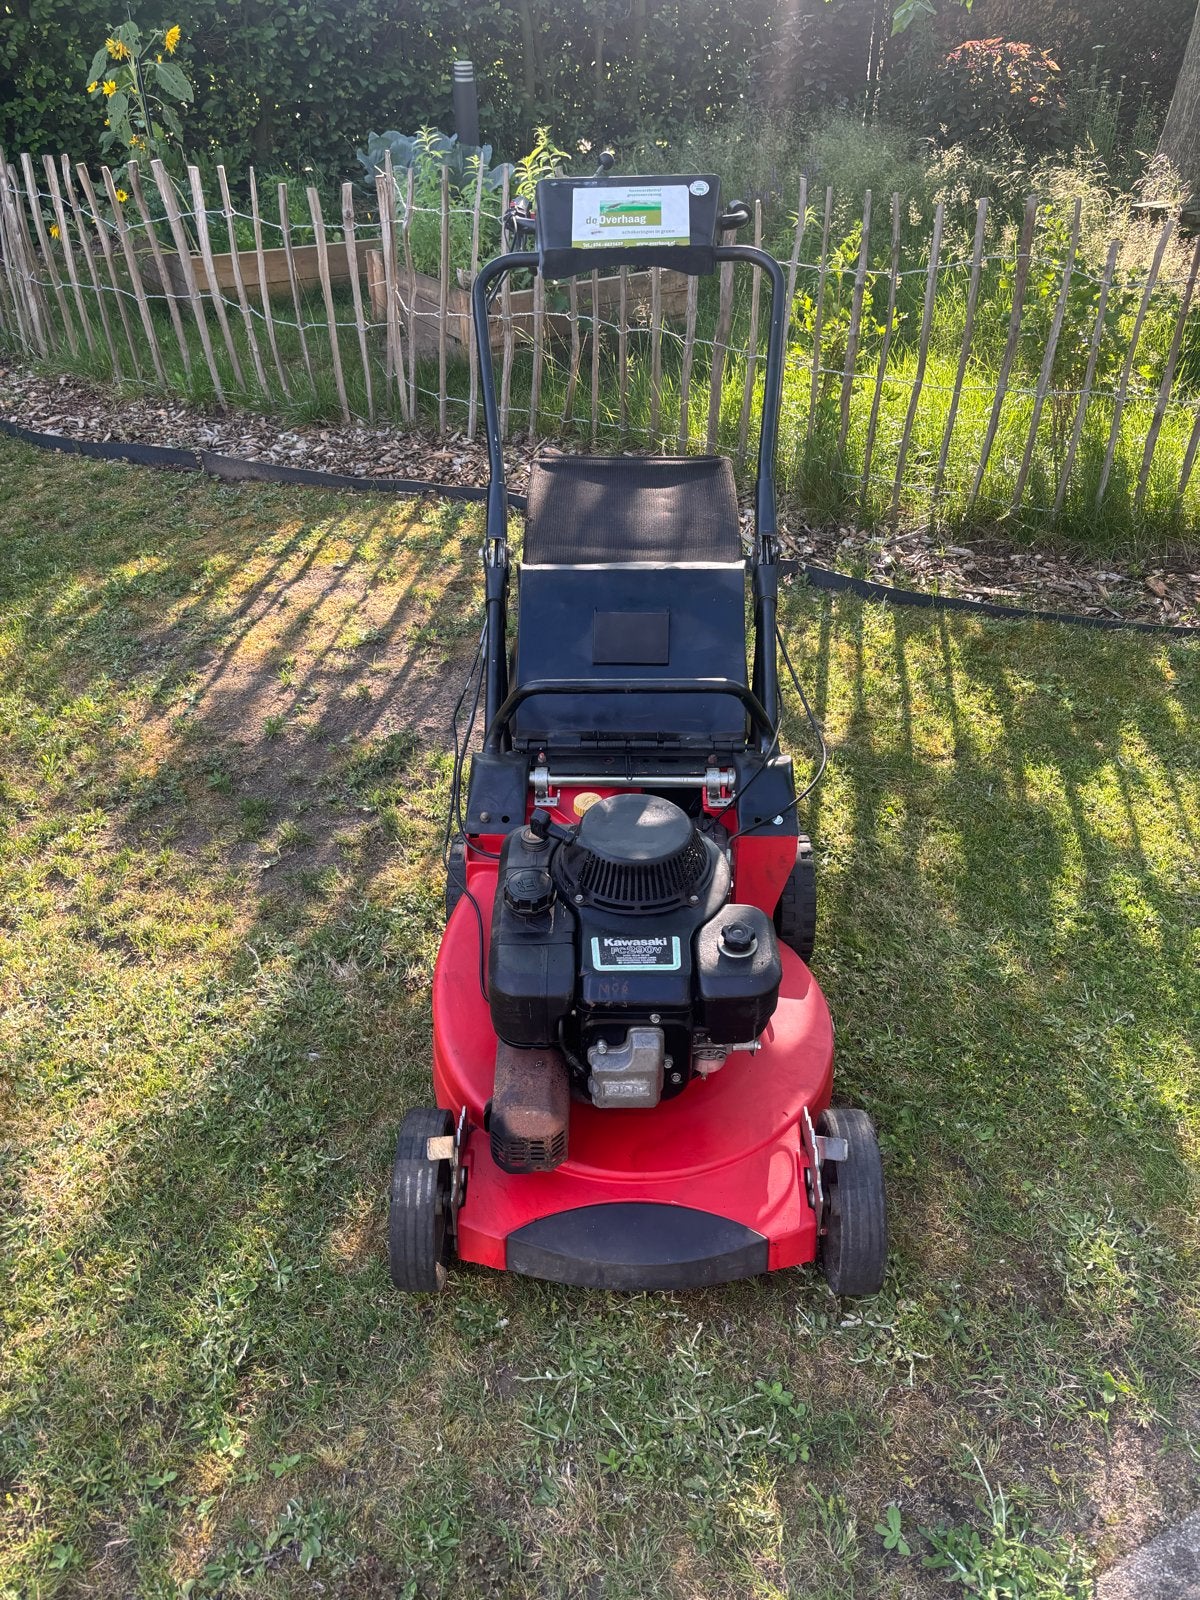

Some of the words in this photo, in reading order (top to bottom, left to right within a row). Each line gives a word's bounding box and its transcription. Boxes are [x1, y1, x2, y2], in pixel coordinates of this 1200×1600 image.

[586, 216, 598, 225] de
[599, 214, 647, 225] Overhaag
[604, 937, 668, 947] Kawasaki
